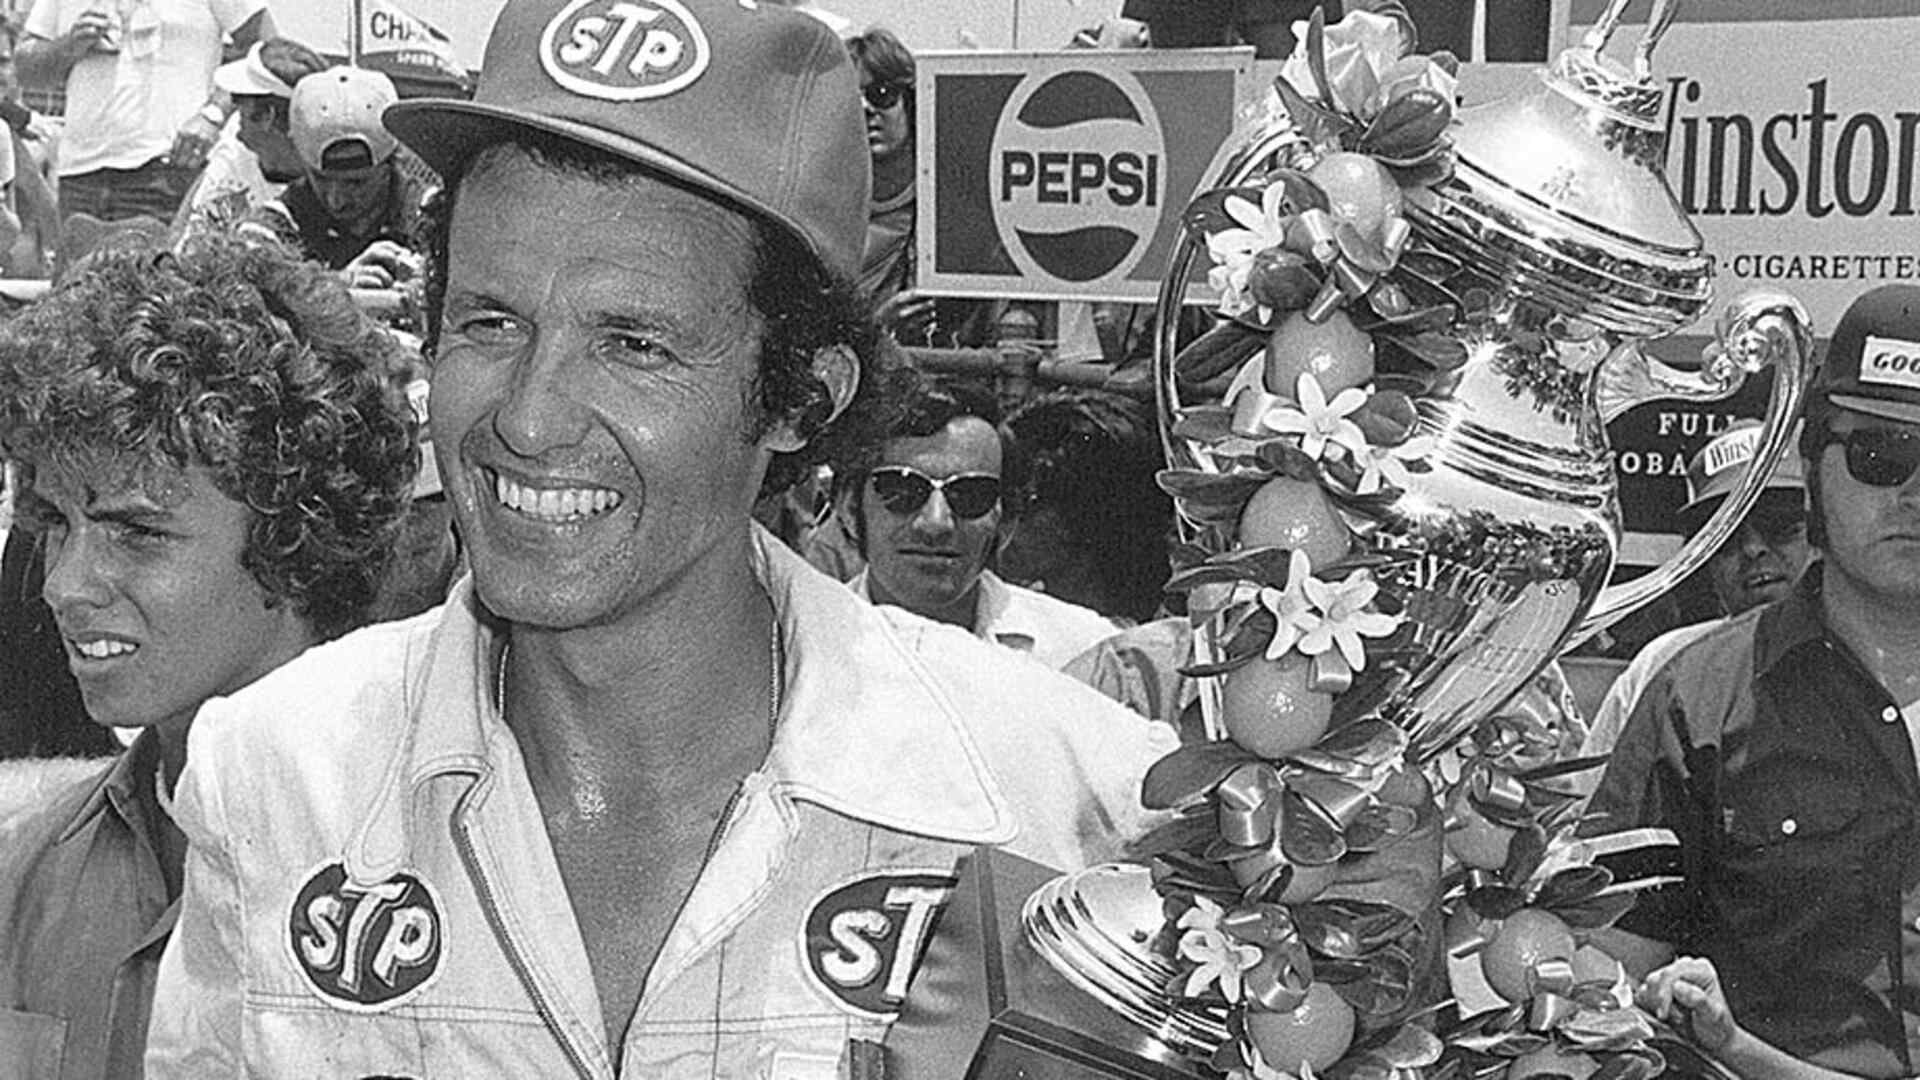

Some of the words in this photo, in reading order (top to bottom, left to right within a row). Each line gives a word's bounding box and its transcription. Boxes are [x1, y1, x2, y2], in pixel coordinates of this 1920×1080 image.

[559, 3, 683, 76] STP
[1002, 152, 1157, 206] PEPSI
[1620, 452, 1687, 475] OBA
[301, 882, 438, 994] STP
[820, 887, 950, 1001] ST
